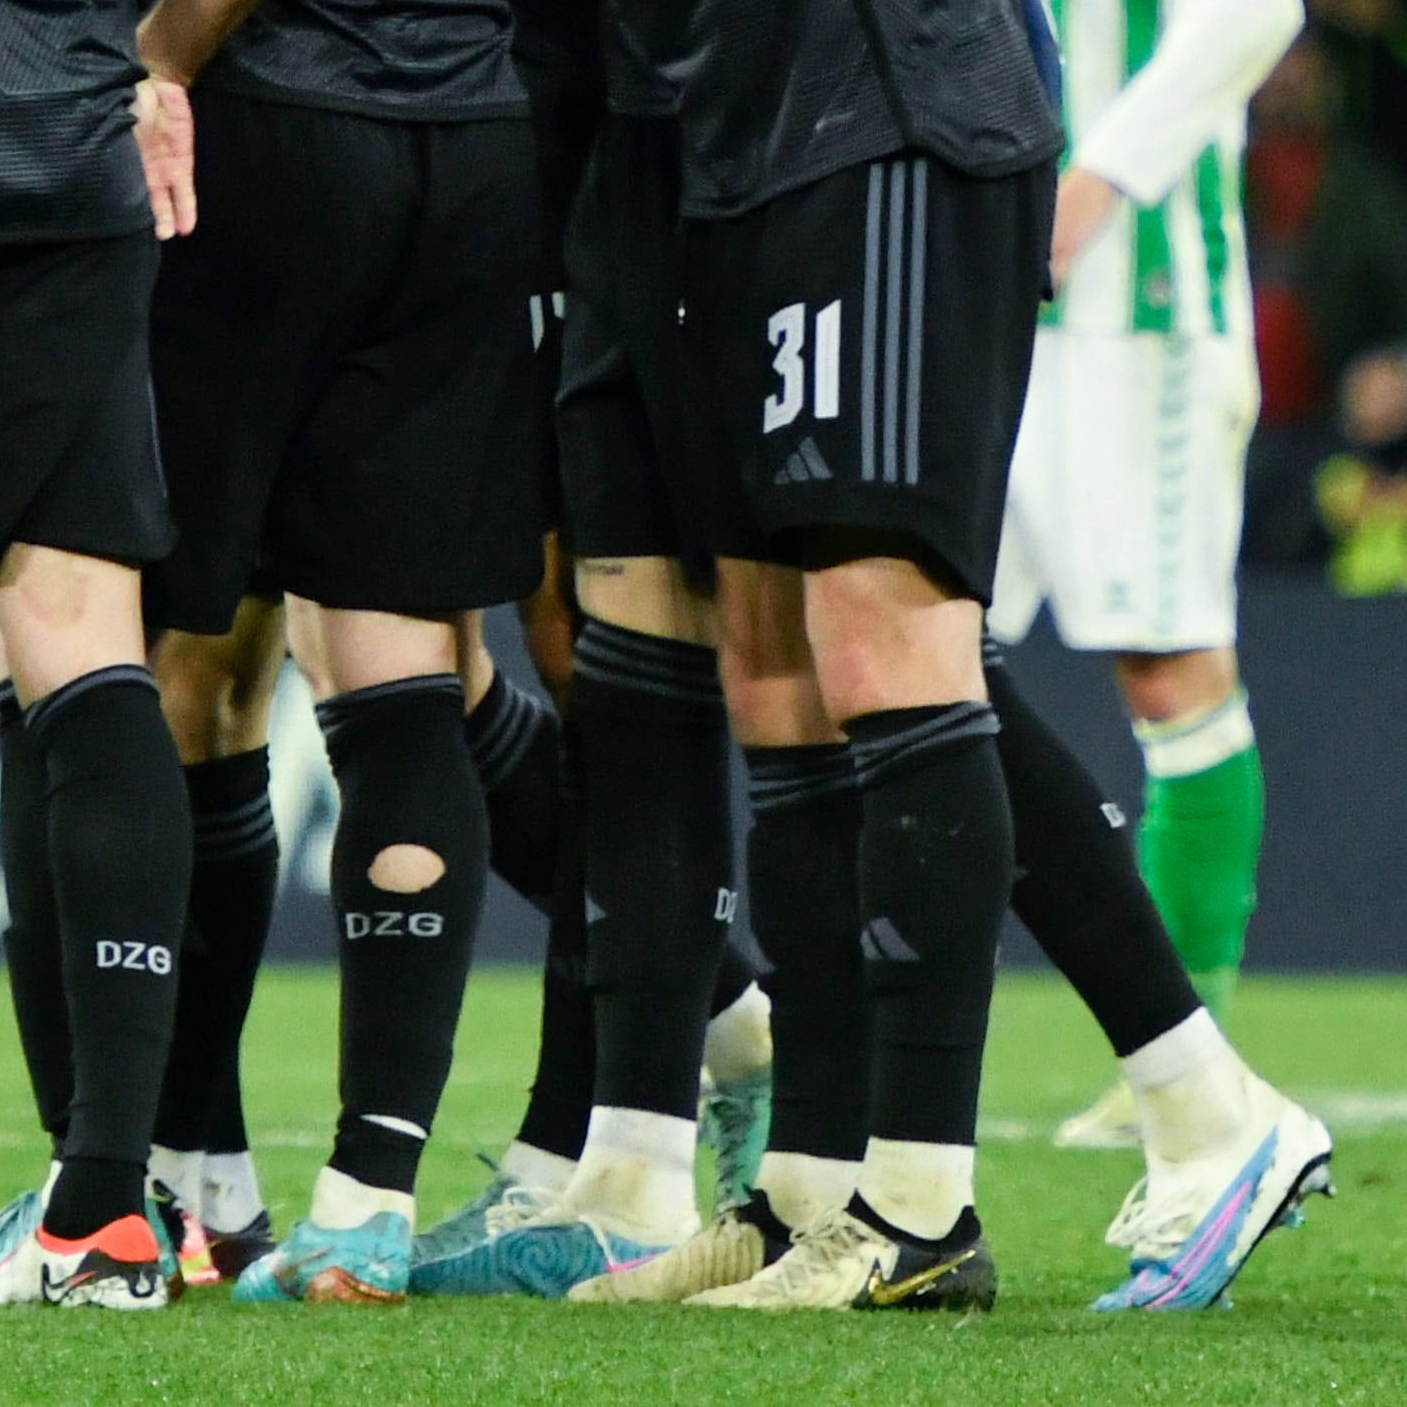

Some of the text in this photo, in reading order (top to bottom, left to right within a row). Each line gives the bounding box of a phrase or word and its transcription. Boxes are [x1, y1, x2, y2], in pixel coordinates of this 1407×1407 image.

[762, 298, 842, 435] 31
[345, 910, 444, 940] DZG
[95, 939, 172, 975] DZG
